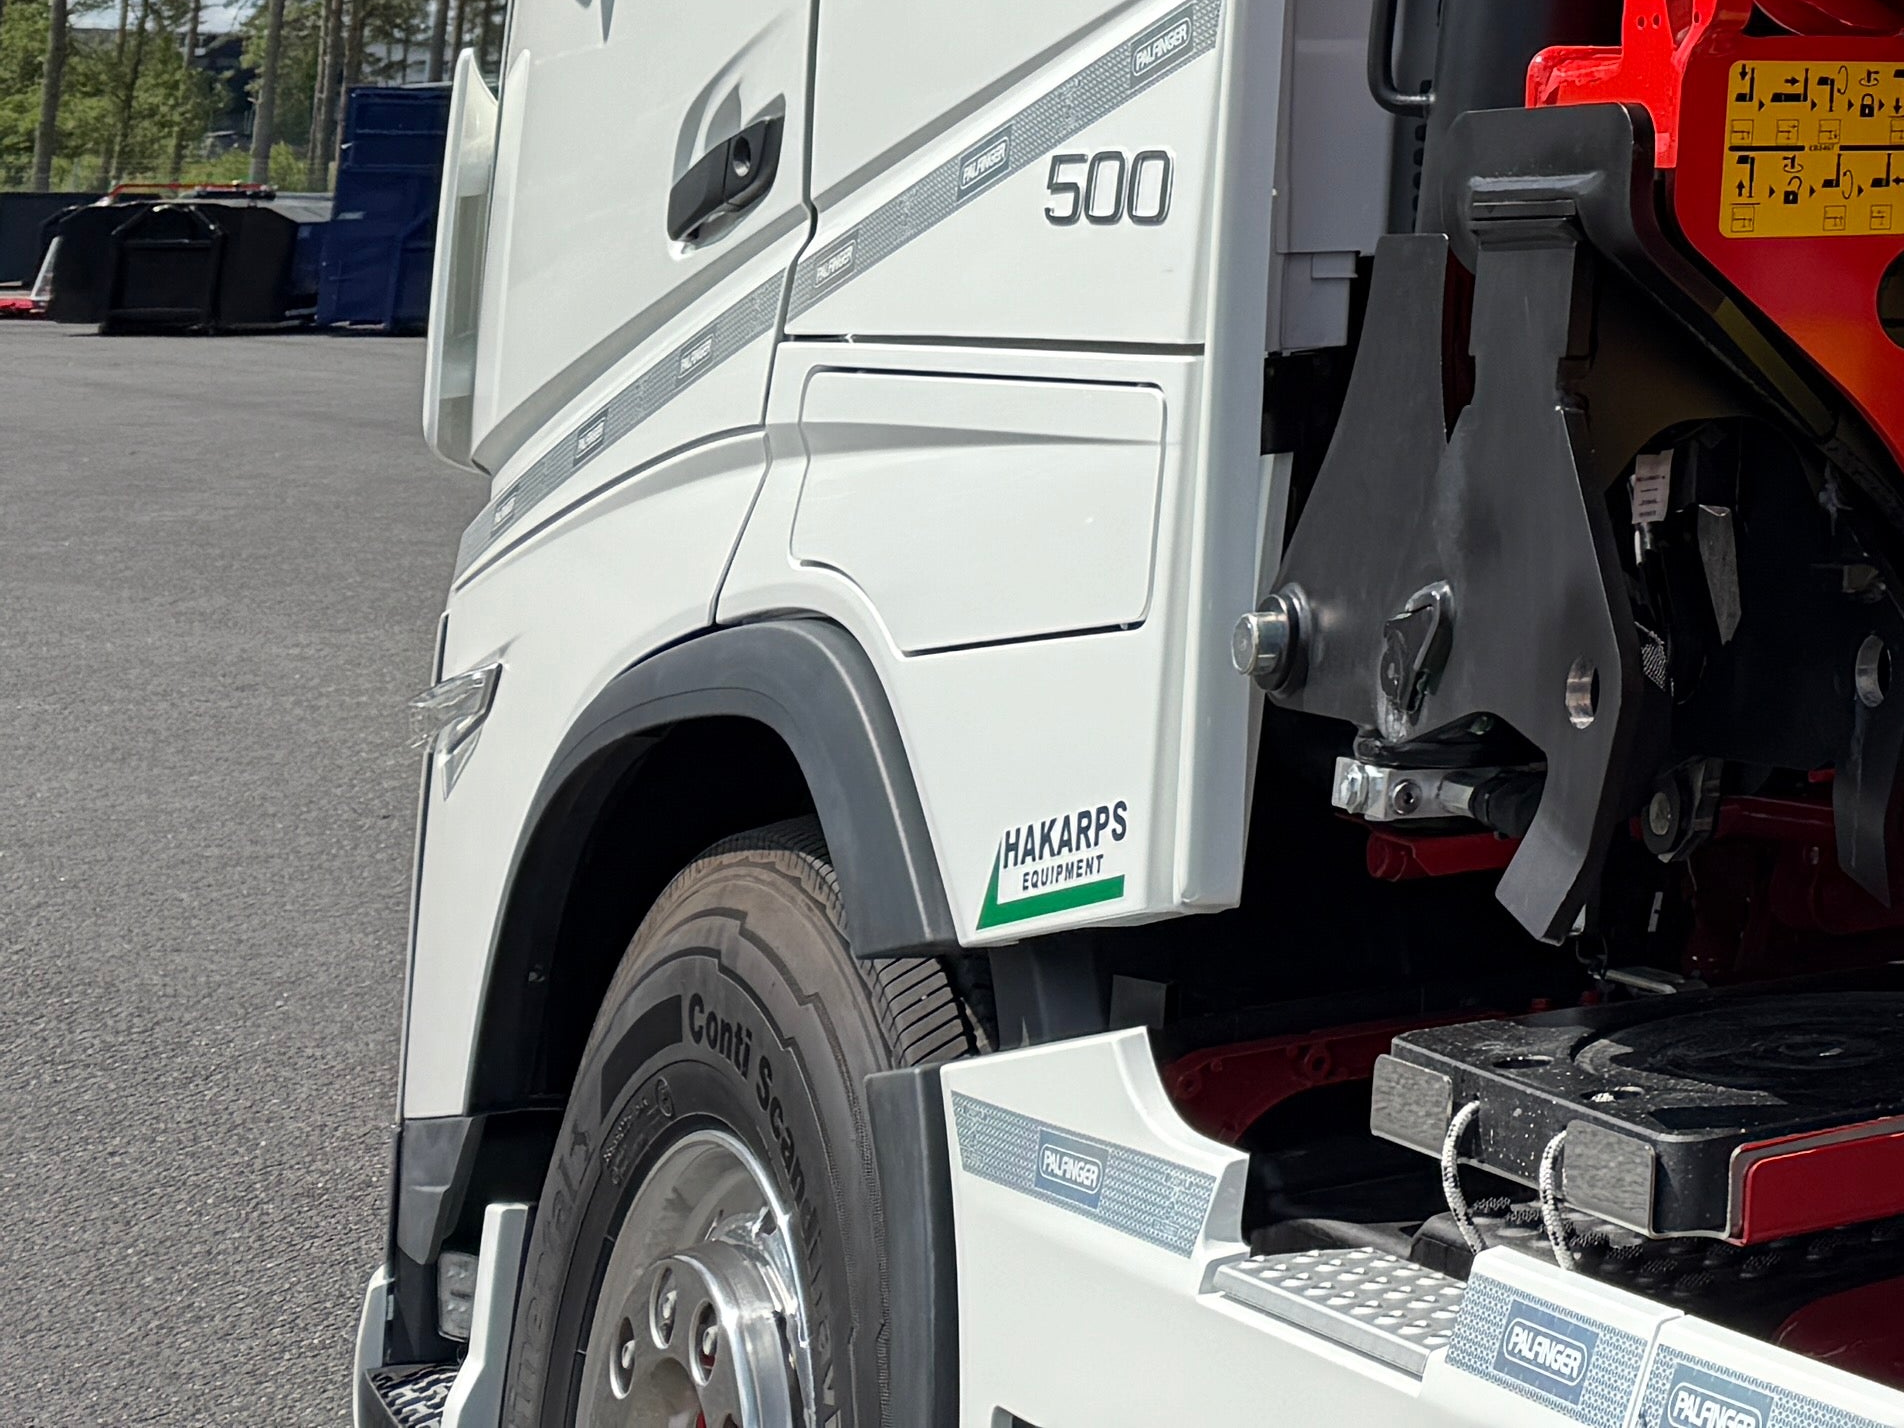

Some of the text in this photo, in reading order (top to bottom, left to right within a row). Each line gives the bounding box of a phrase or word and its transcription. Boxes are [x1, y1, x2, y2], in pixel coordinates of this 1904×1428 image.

[1135, 23, 1189, 71] PALFINGER
[960, 143, 1007, 186] PALFINGER
[1044, 150, 1174, 227] 500
[1003, 800, 1128, 870] HAKARPS
[1022, 853, 1105, 892] EQUIPMENT
[688, 992, 754, 1081] Conti
[1043, 1149, 1099, 1188] PALFINGER
[1507, 1324, 1583, 1379] PALFINGER
